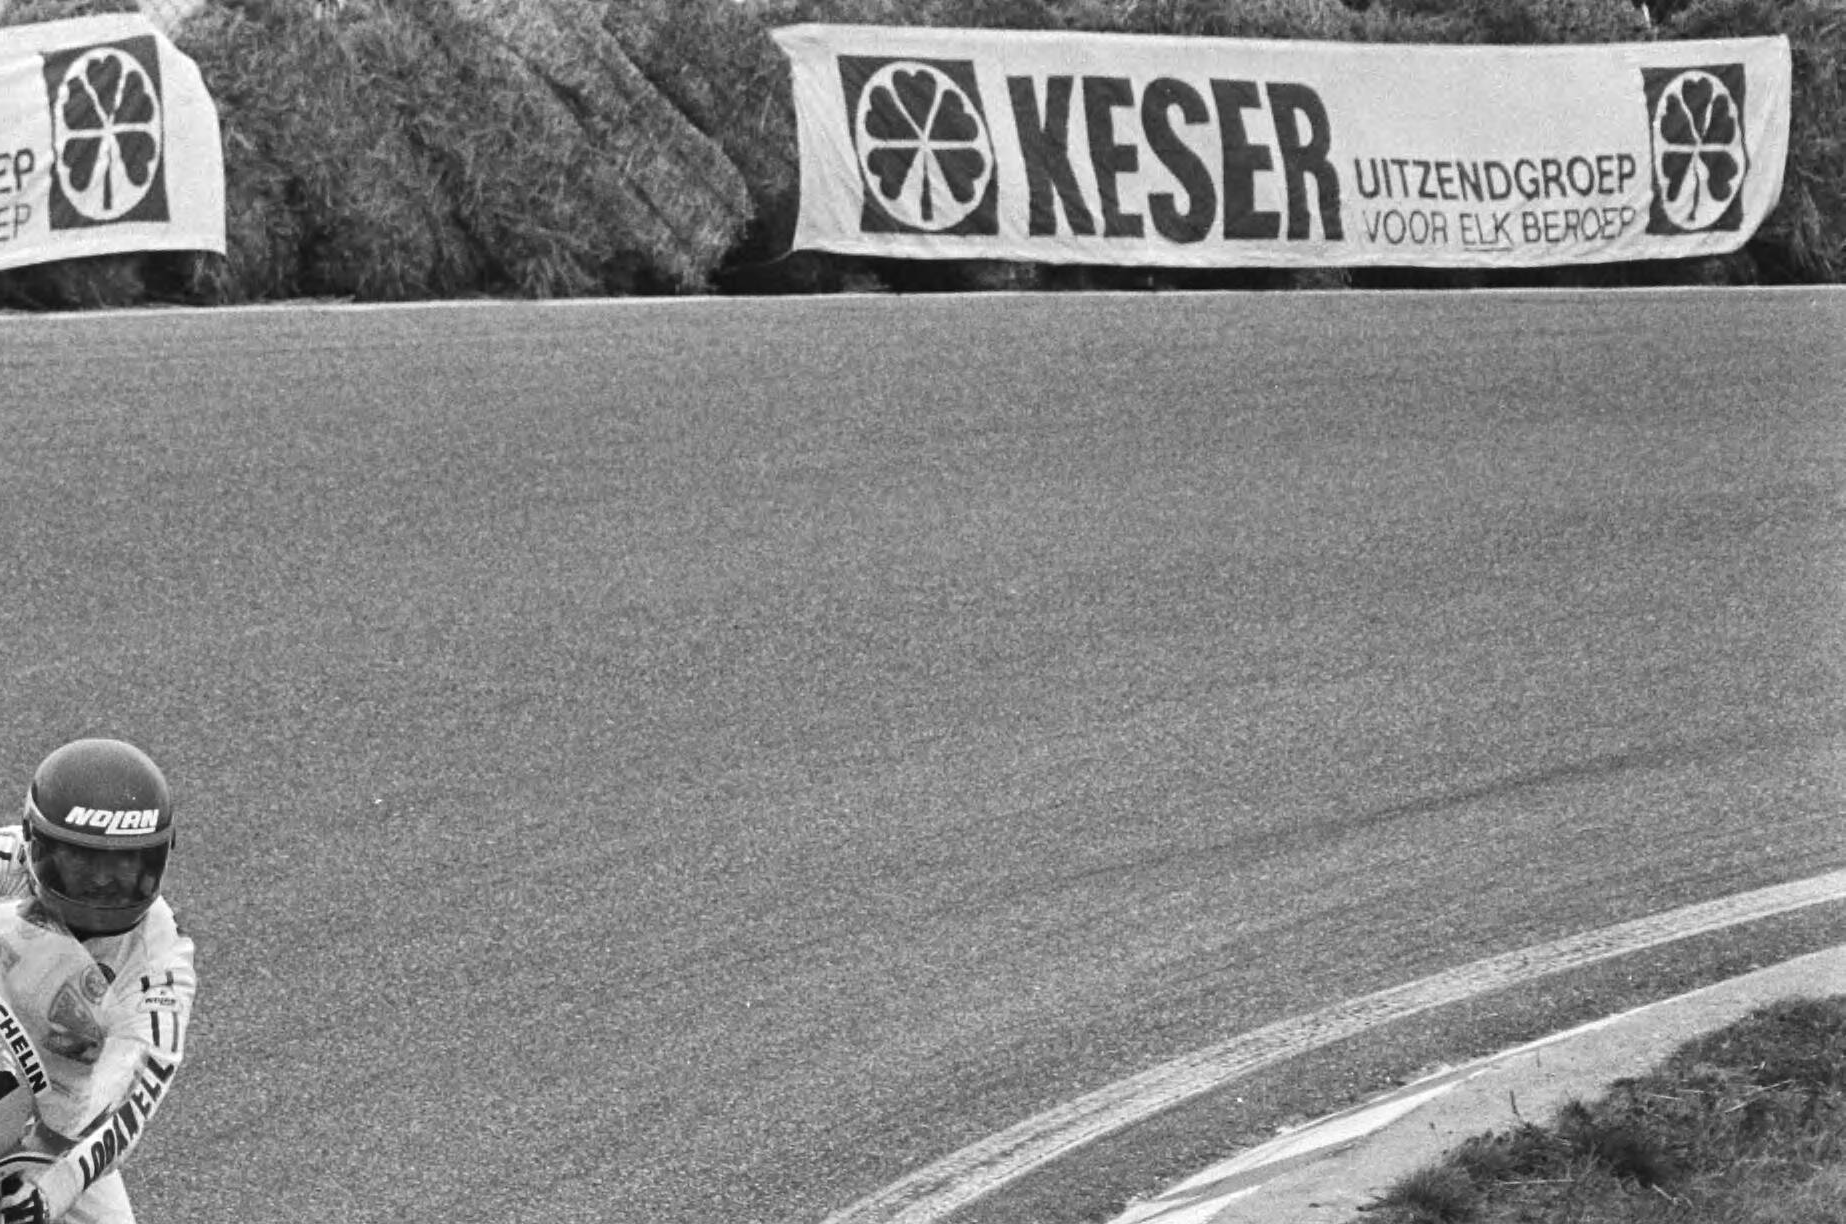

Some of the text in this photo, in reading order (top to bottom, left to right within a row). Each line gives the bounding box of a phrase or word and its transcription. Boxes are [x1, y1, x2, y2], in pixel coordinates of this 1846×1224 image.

[1006, 74, 1344, 244] KESER
[1354, 153, 1636, 201] UITZENDGROEP
[1362, 206, 1636, 247] VOOR ELK BEROEP
[64, 805, 159, 835] NOLAN
